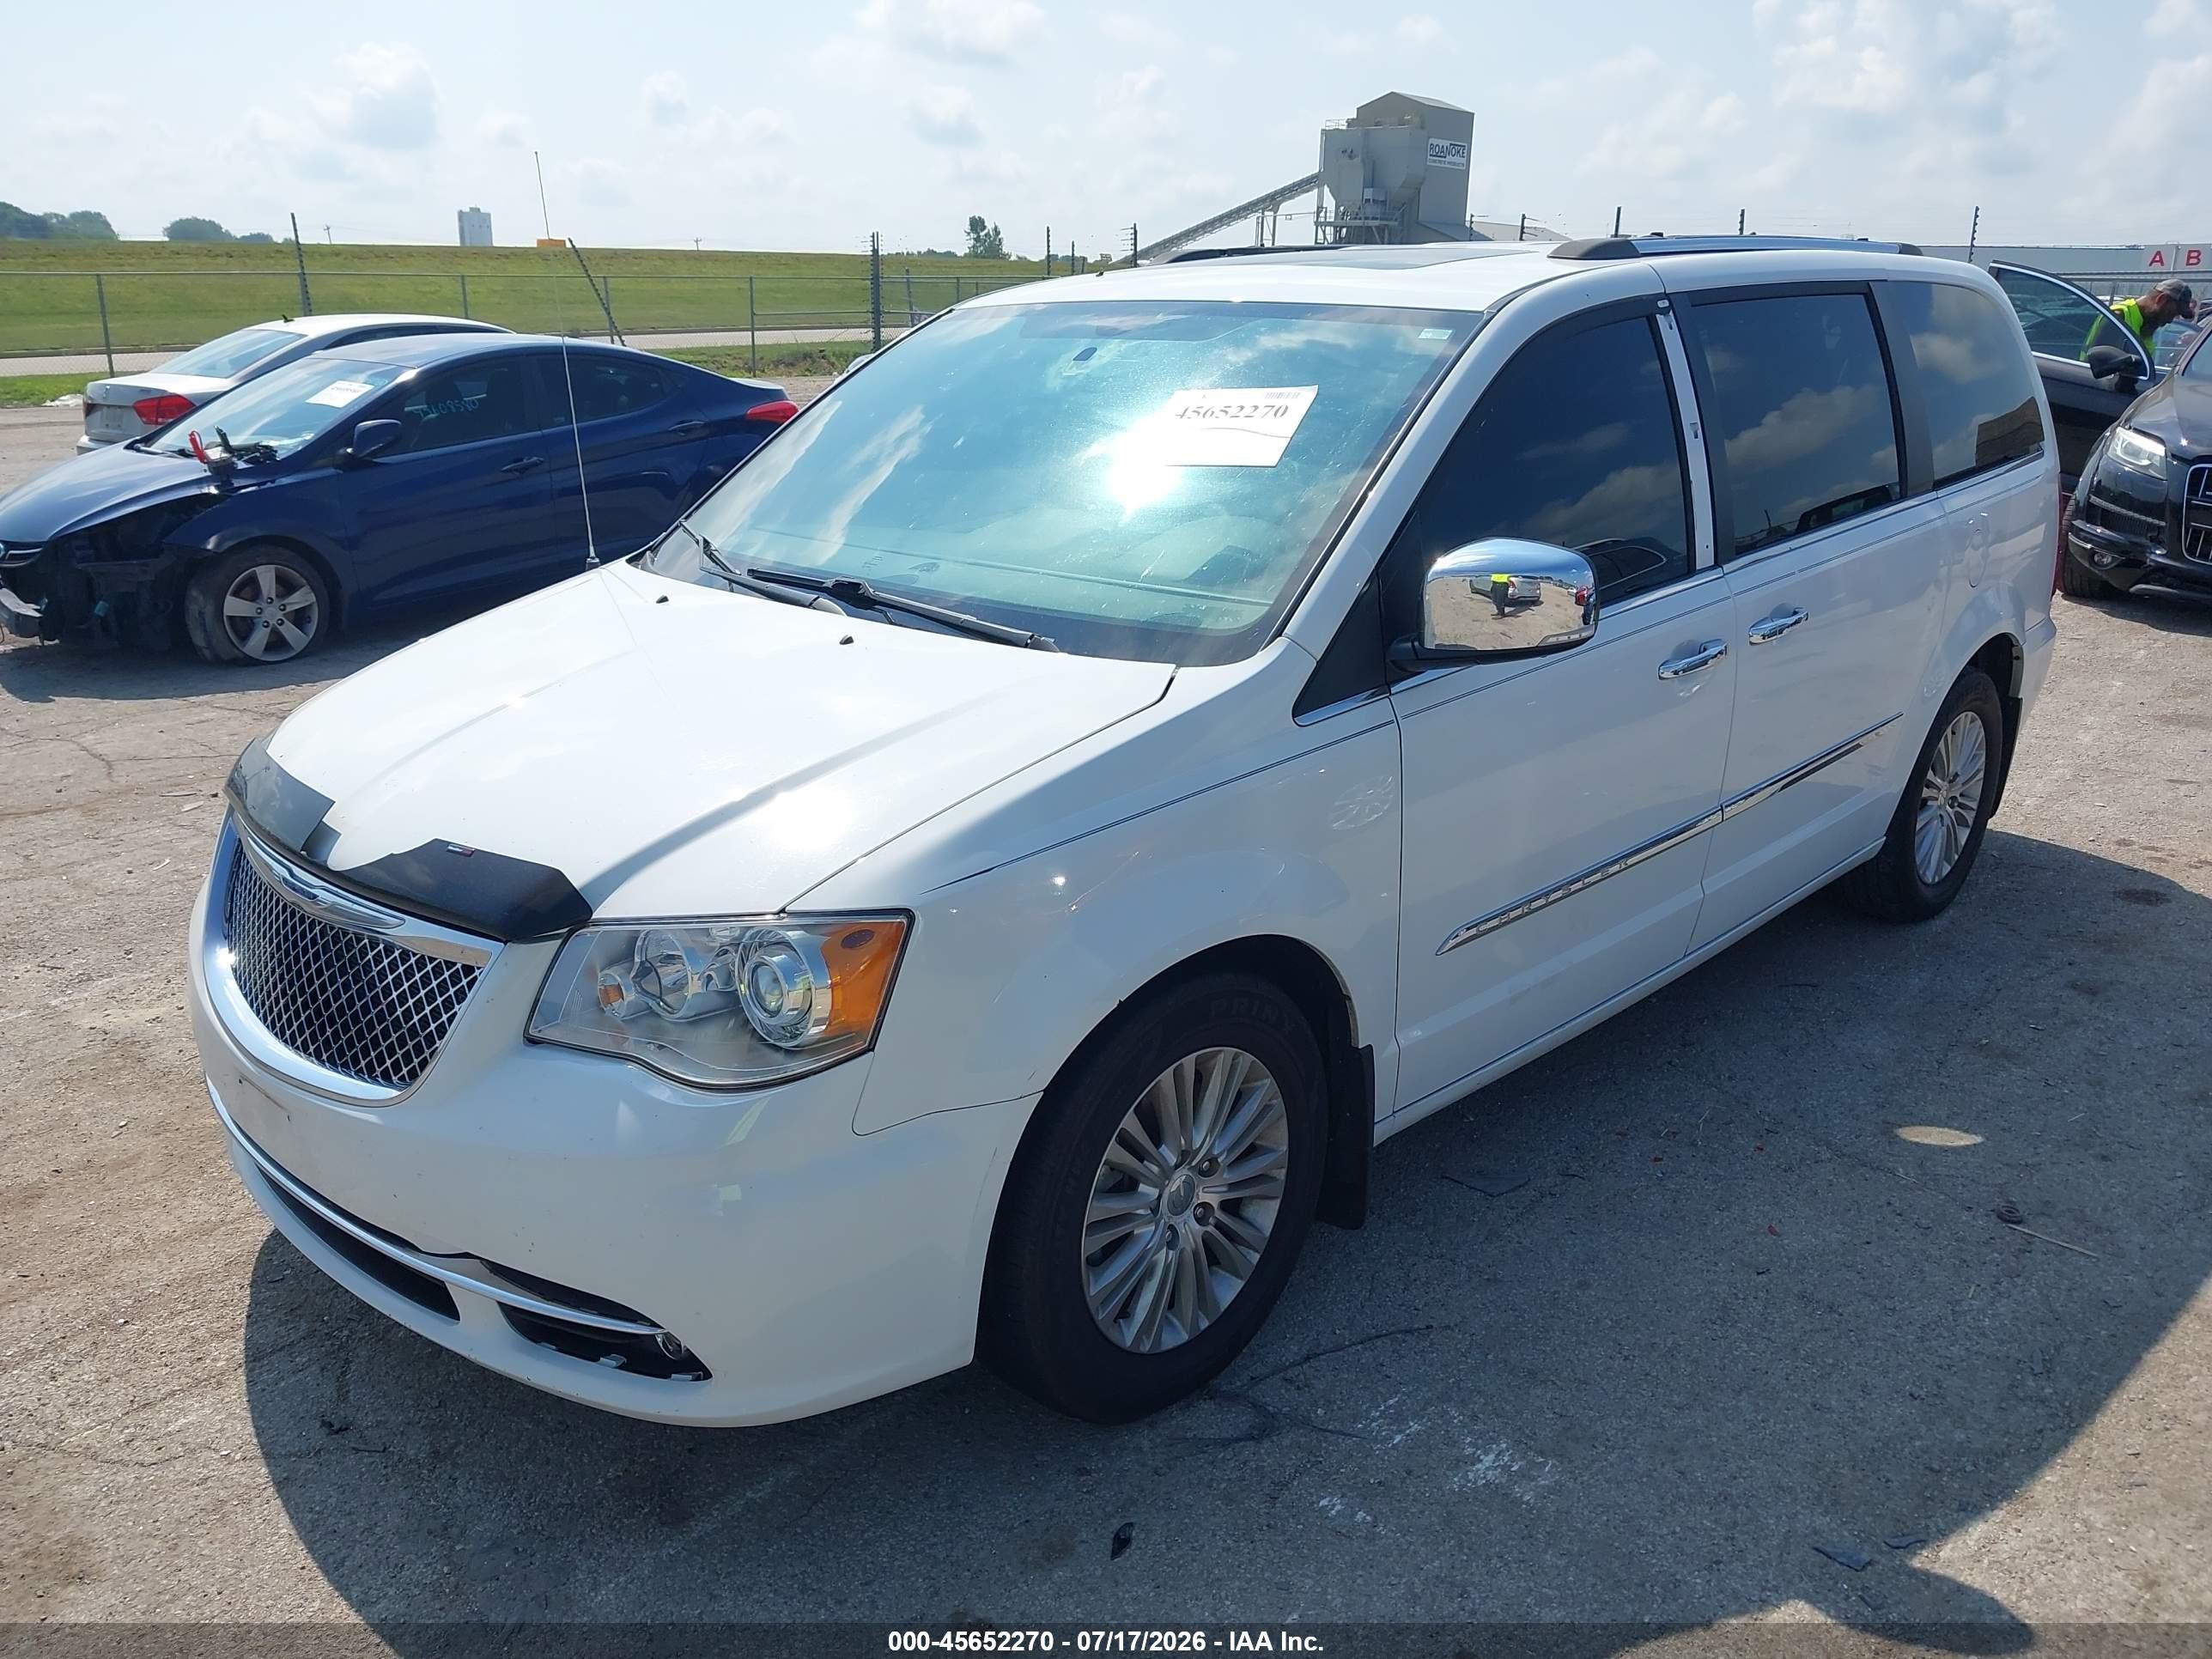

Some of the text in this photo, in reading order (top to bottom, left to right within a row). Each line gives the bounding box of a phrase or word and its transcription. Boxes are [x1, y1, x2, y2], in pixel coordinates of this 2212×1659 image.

[1429, 143, 1466, 159] ROANOKE
[2148, 249, 2202, 267] A B
[1175, 404, 1289, 419] 45652270
